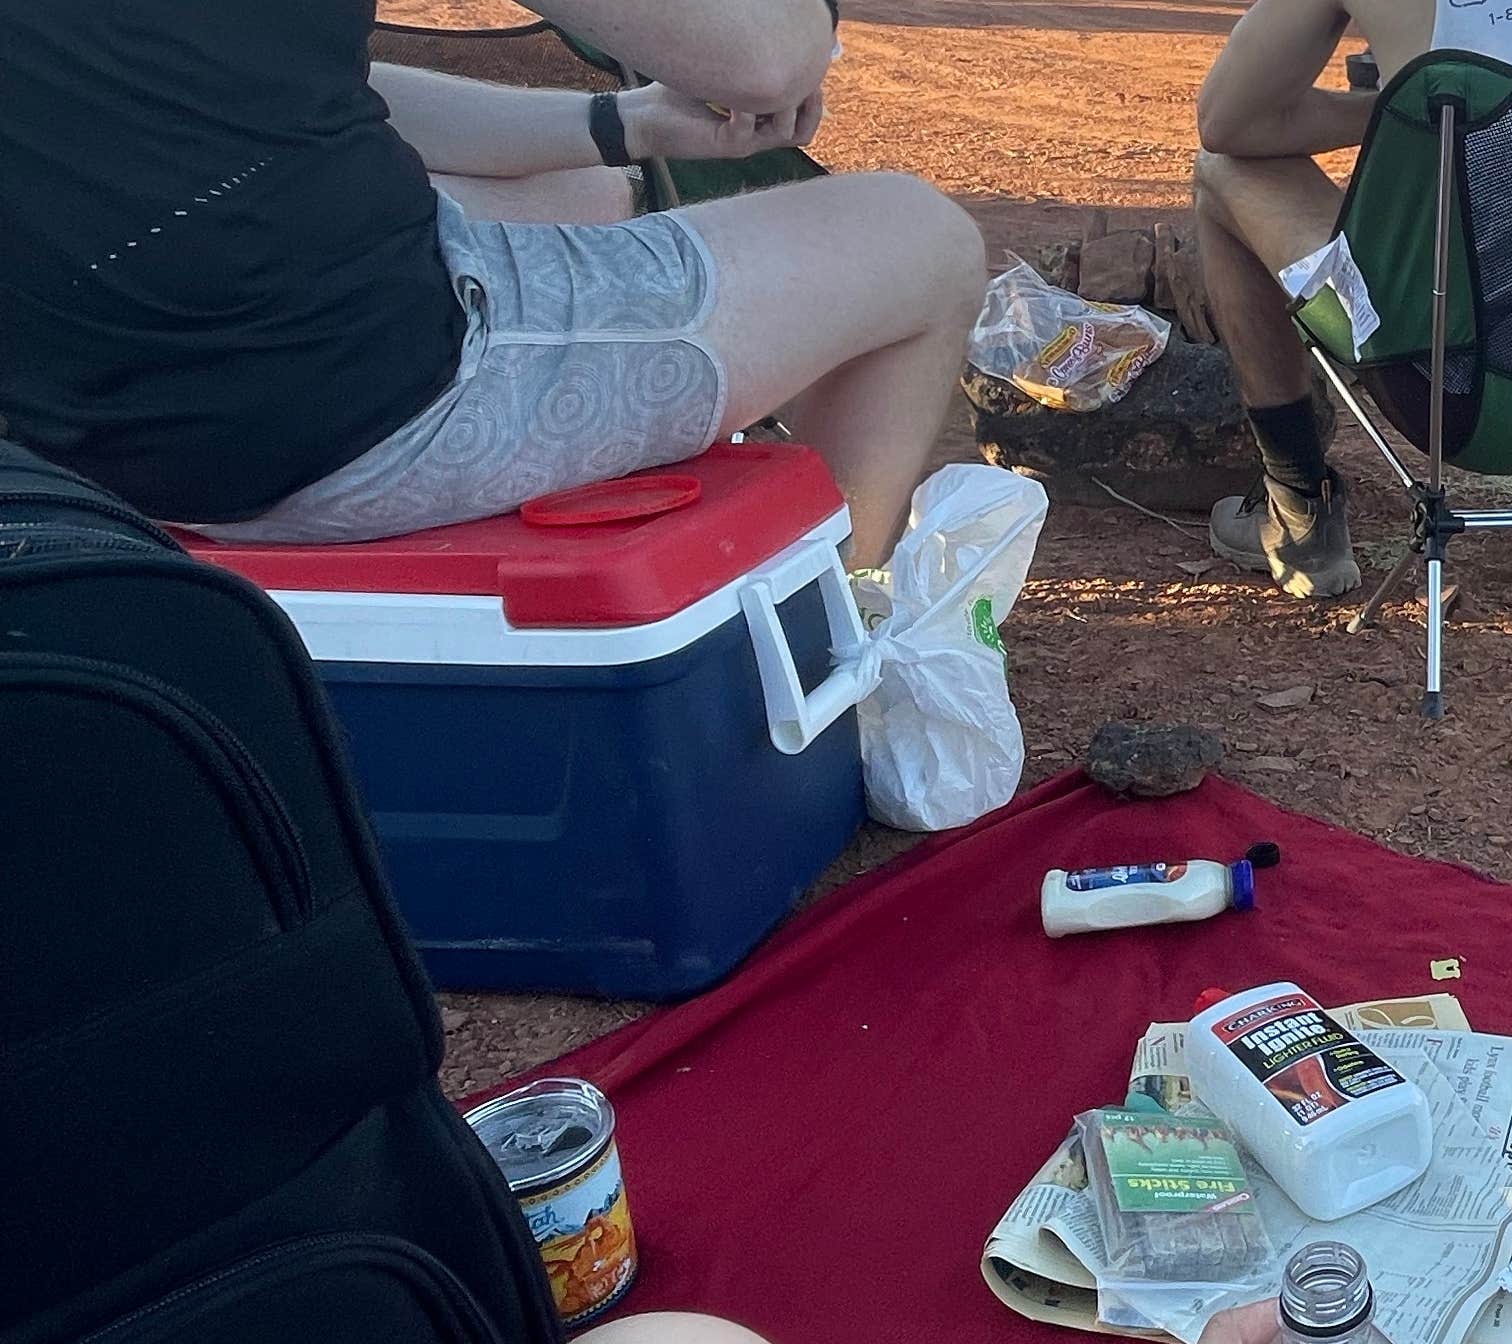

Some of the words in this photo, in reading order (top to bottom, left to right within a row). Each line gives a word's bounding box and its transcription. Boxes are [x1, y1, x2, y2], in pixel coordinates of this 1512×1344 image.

[1240, 1010, 1325, 1050] Instant
[1257, 1023, 1327, 1057] Ignite
[1262, 1039, 1313, 1070] LIGHTER
[1127, 1177, 1192, 1192] Sticks
[1154, 1190, 1218, 1201] Waterproof
[1196, 1179, 1237, 1194] Fire
